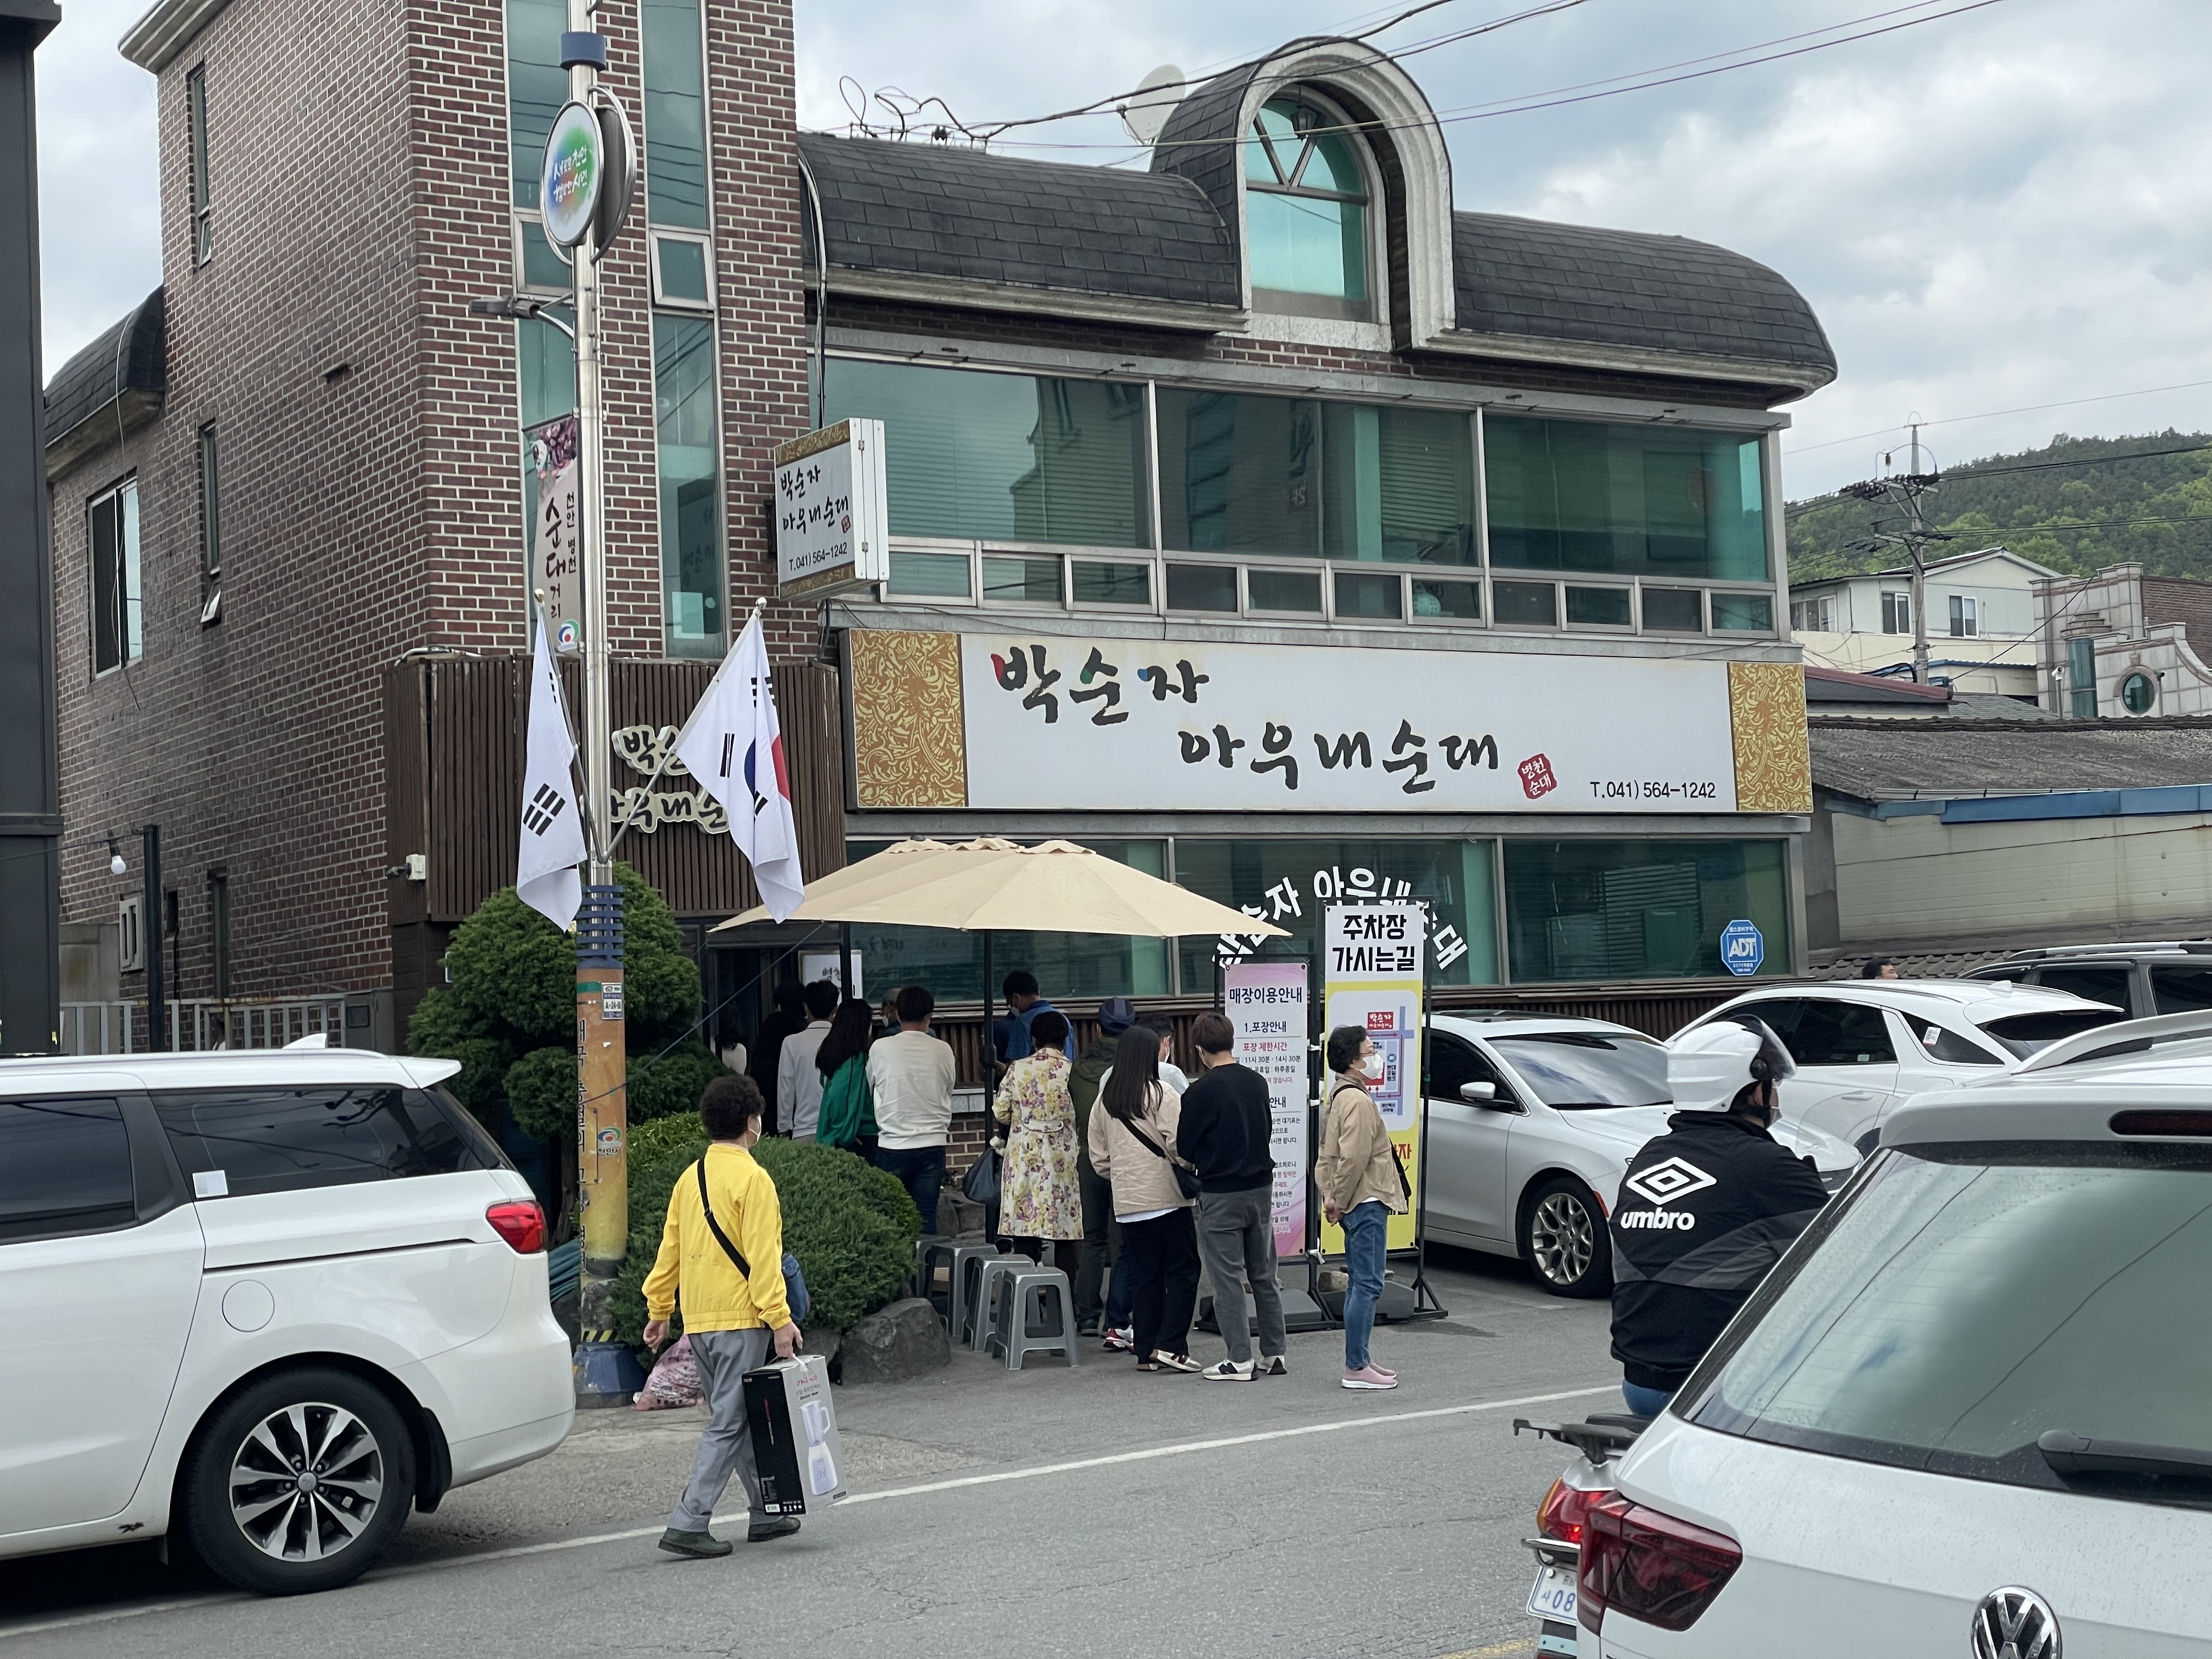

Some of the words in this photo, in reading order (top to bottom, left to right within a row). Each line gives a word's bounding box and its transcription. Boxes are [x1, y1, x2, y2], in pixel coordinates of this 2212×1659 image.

[572, 144, 587, 167] 천안
[572, 169, 588, 193] 시민
[781, 465, 821, 501] 박순자
[566, 492, 575, 529] 천안
[783, 495, 848, 534] 아우내순대
[568, 535, 576, 574] 병천
[991, 645, 1210, 726] 박순자
[623, 730, 687, 769] 박순
[1178, 719, 1498, 794] 아우내순대
[1521, 758, 1547, 779] 병천
[1530, 774, 1552, 795] 순대
[611, 793, 728, 828] 우내순
[1343, 915, 1407, 940] 주차장
[1332, 946, 1415, 972] 가시는길
[1729, 938, 1756, 957] ADT
[1229, 987, 1302, 1004] 매장이용안내
[1245, 1021, 1286, 1032] 1.포장안내
[1243, 1042, 1257, 1052] 포장
[1259, 1042, 1287, 1052] 제한시간
[1621, 1207, 1695, 1230] umbro
[1553, 1589, 1576, 1612] 08
